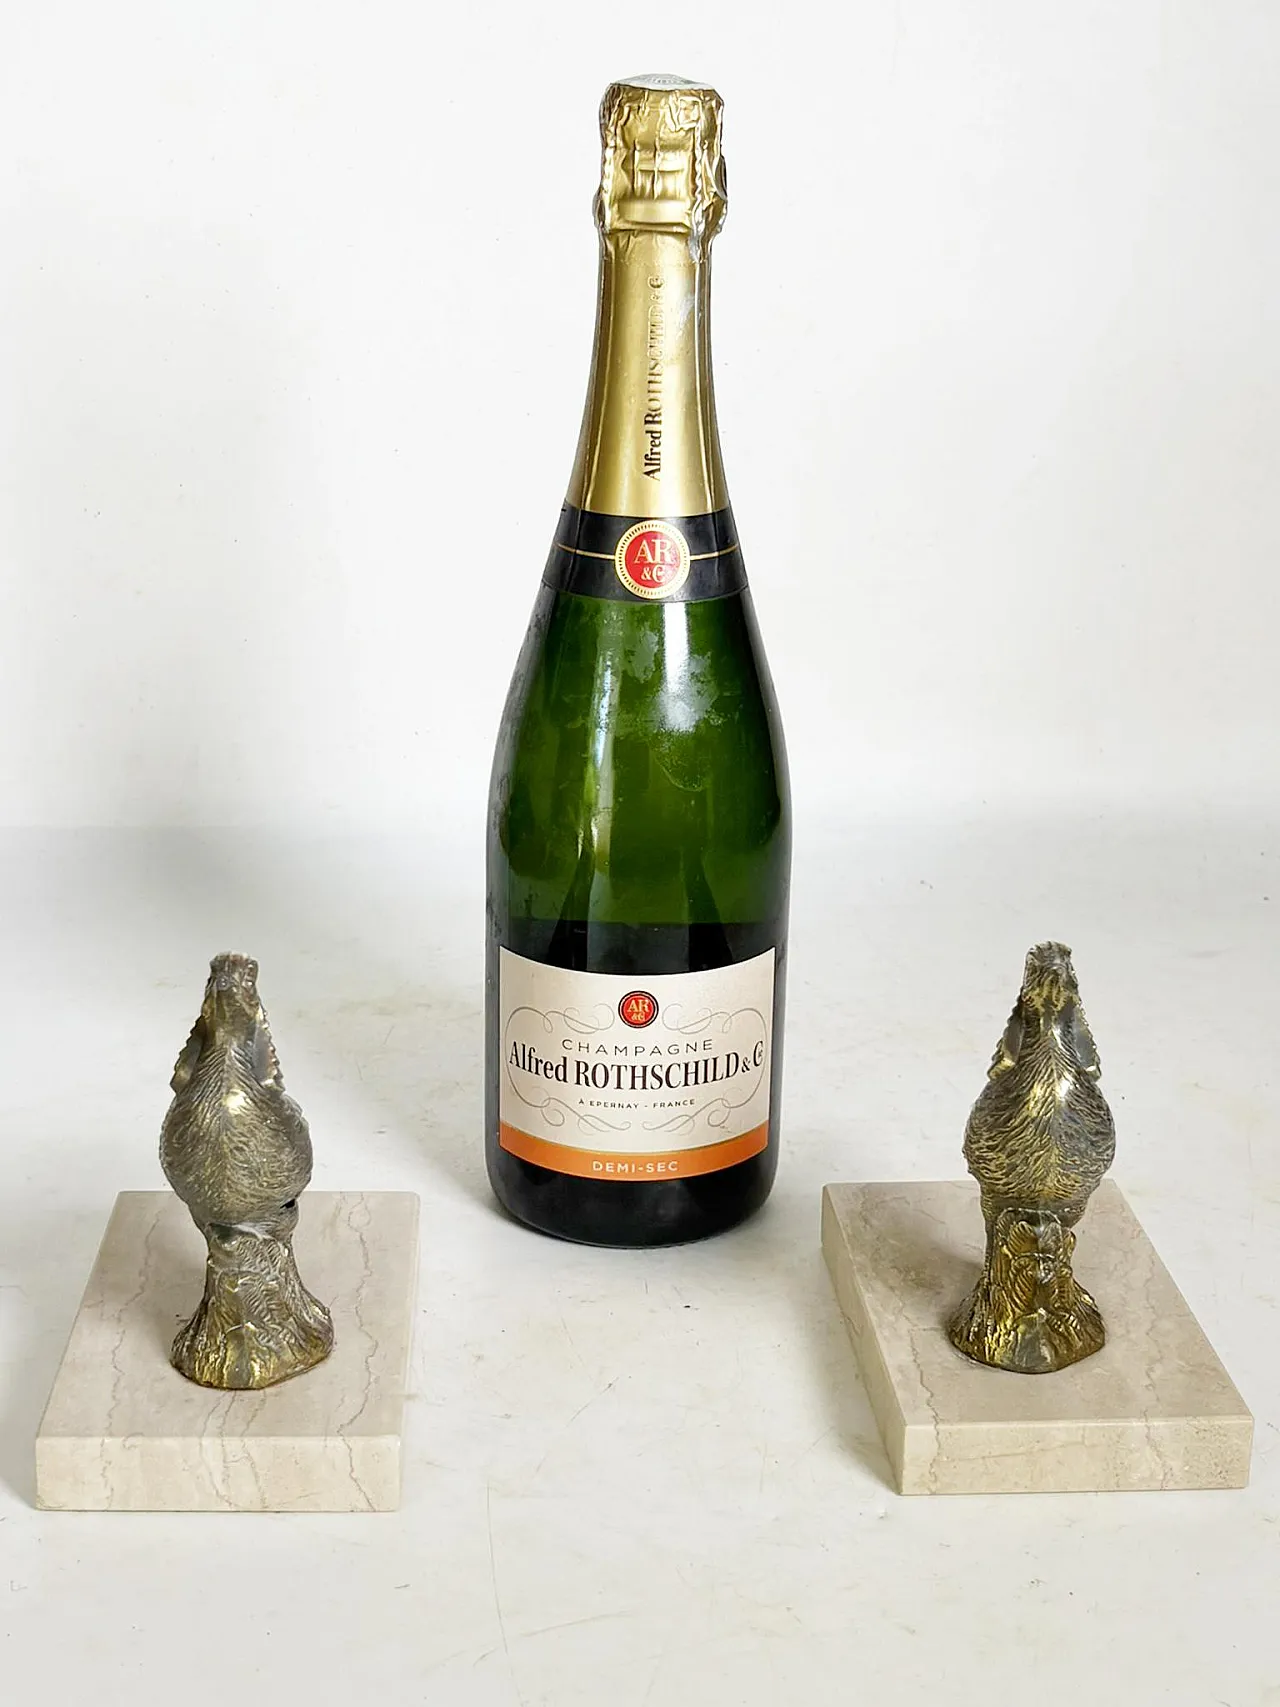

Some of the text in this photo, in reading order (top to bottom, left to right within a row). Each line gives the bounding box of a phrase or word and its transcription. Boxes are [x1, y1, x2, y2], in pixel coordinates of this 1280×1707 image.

[643, 430, 662, 481] Alfred
[633, 538, 675, 565] AR
[626, 999, 650, 1013] AR
[561, 1038, 713, 1057] CHAMPAGNE
[509, 1040, 568, 1083] Alfred
[589, 1100, 640, 1110] EPERNAY
[652, 1098, 696, 1109] FRANCE
[592, 1160, 679, 1174] DEMI-SEC
